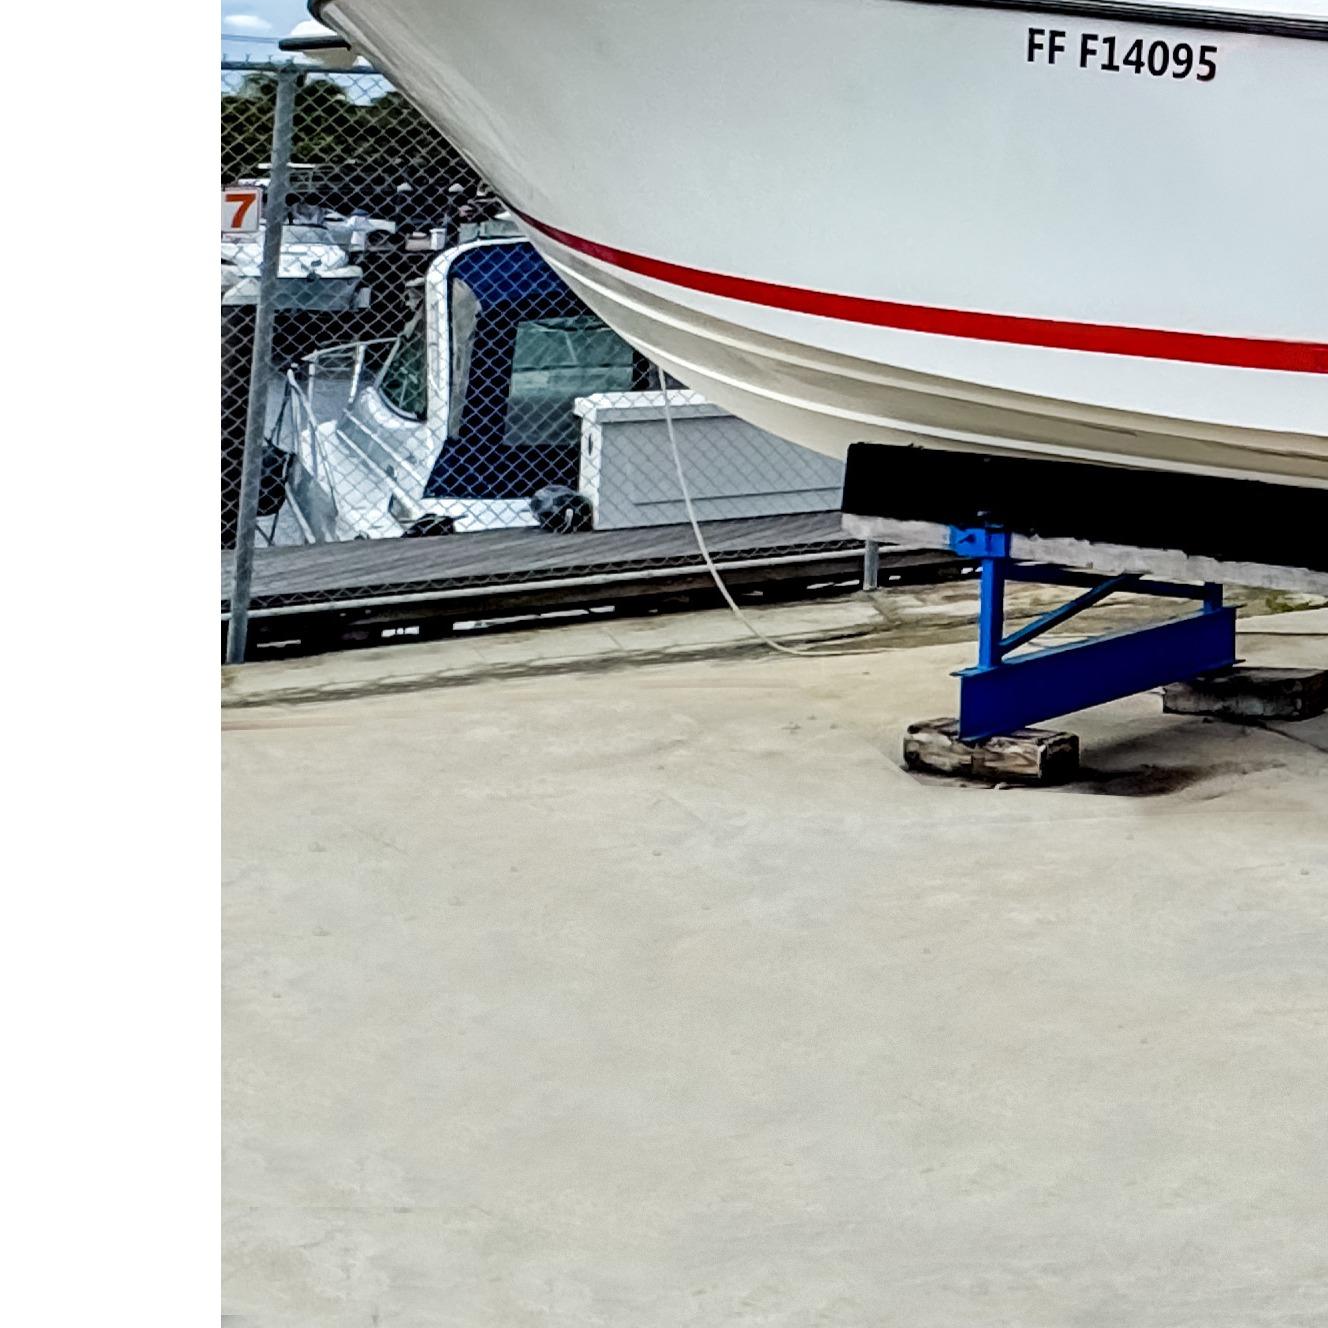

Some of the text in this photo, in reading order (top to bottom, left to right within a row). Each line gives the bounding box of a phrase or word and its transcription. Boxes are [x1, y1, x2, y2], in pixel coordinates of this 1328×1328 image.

[1027, 27, 1218, 82] FF F14095
[225, 193, 257, 228] 7
